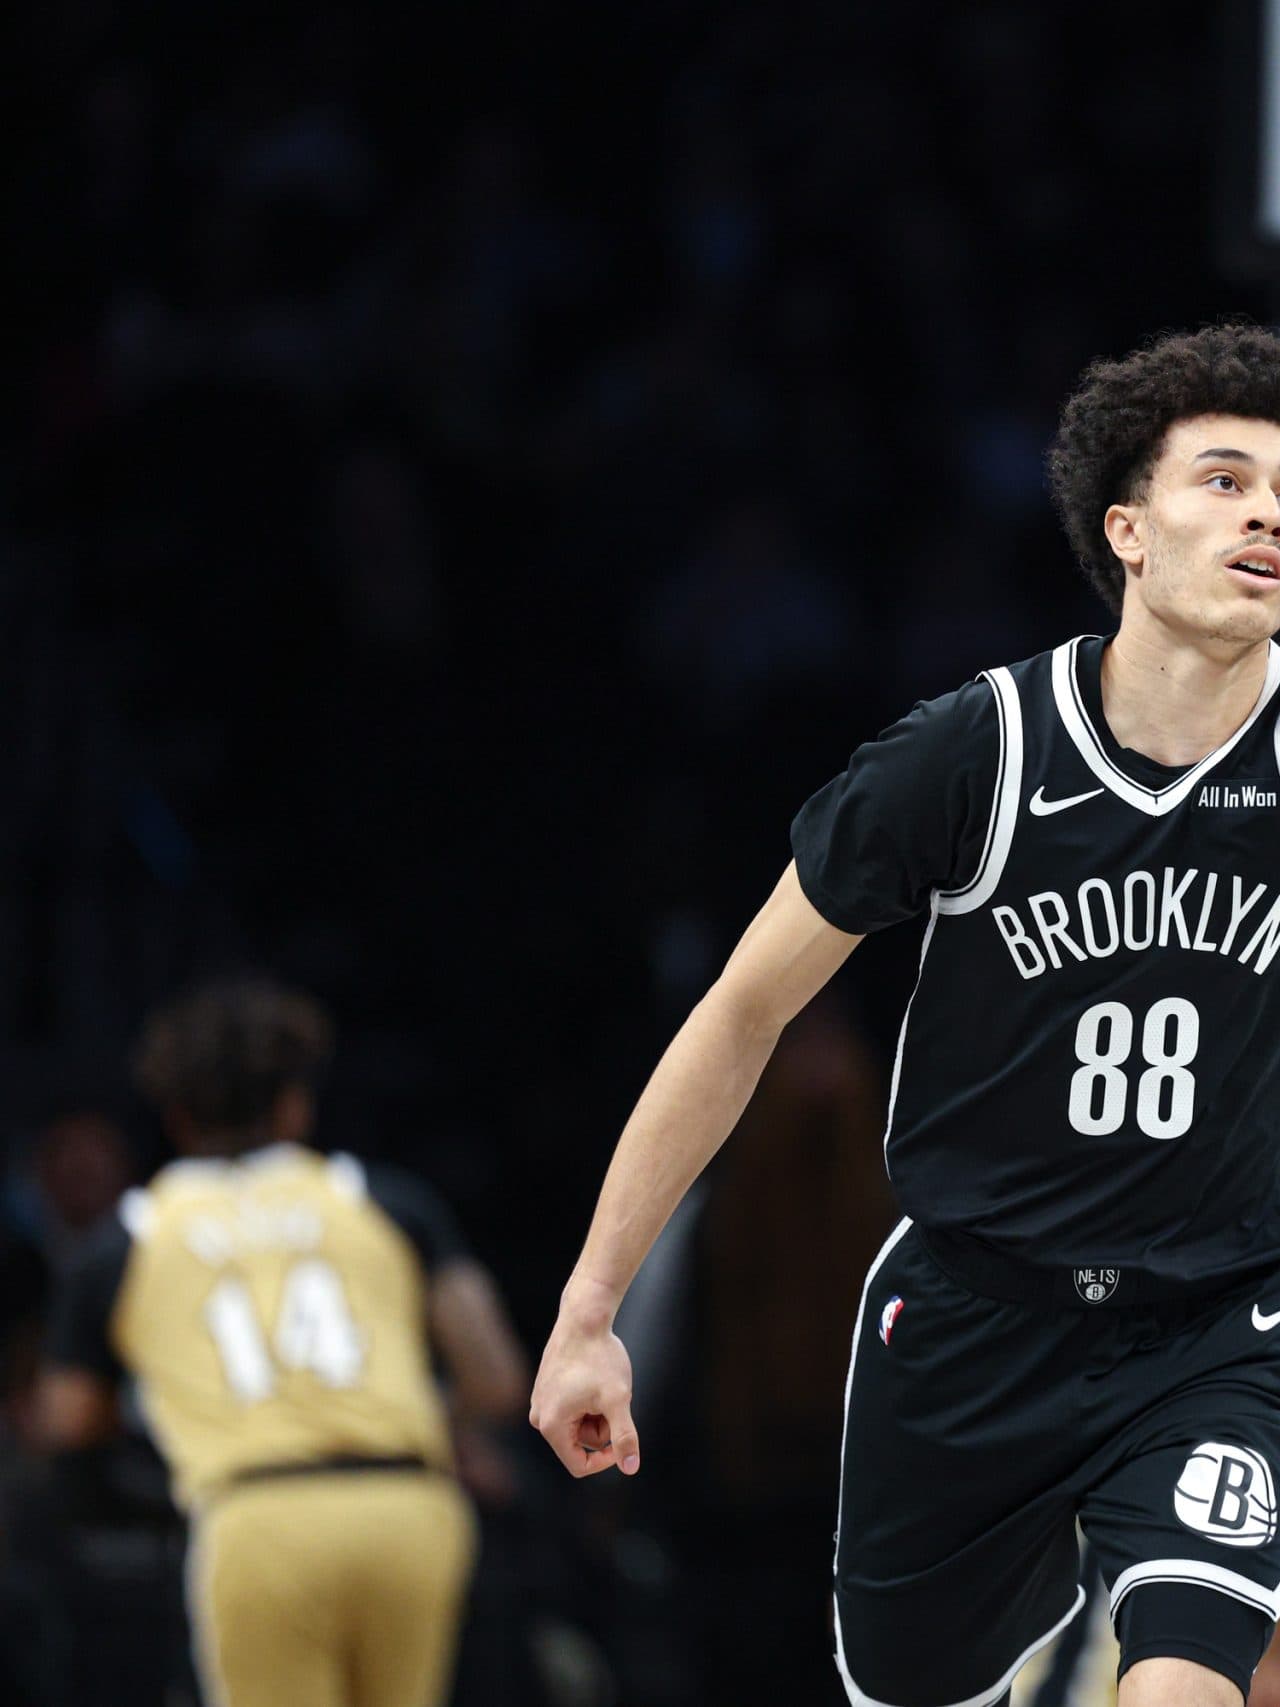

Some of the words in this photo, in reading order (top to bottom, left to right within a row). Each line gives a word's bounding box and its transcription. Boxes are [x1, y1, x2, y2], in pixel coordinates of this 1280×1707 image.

[1198, 785, 1220, 808] All
[1223, 786, 1239, 808] In
[1241, 785, 1277, 808] Won
[1068, 997, 1200, 1139] 88
[1078, 1269, 1115, 1285] NETS
[205, 1260, 364, 1404] 14
[1208, 1455, 1254, 1530] B
